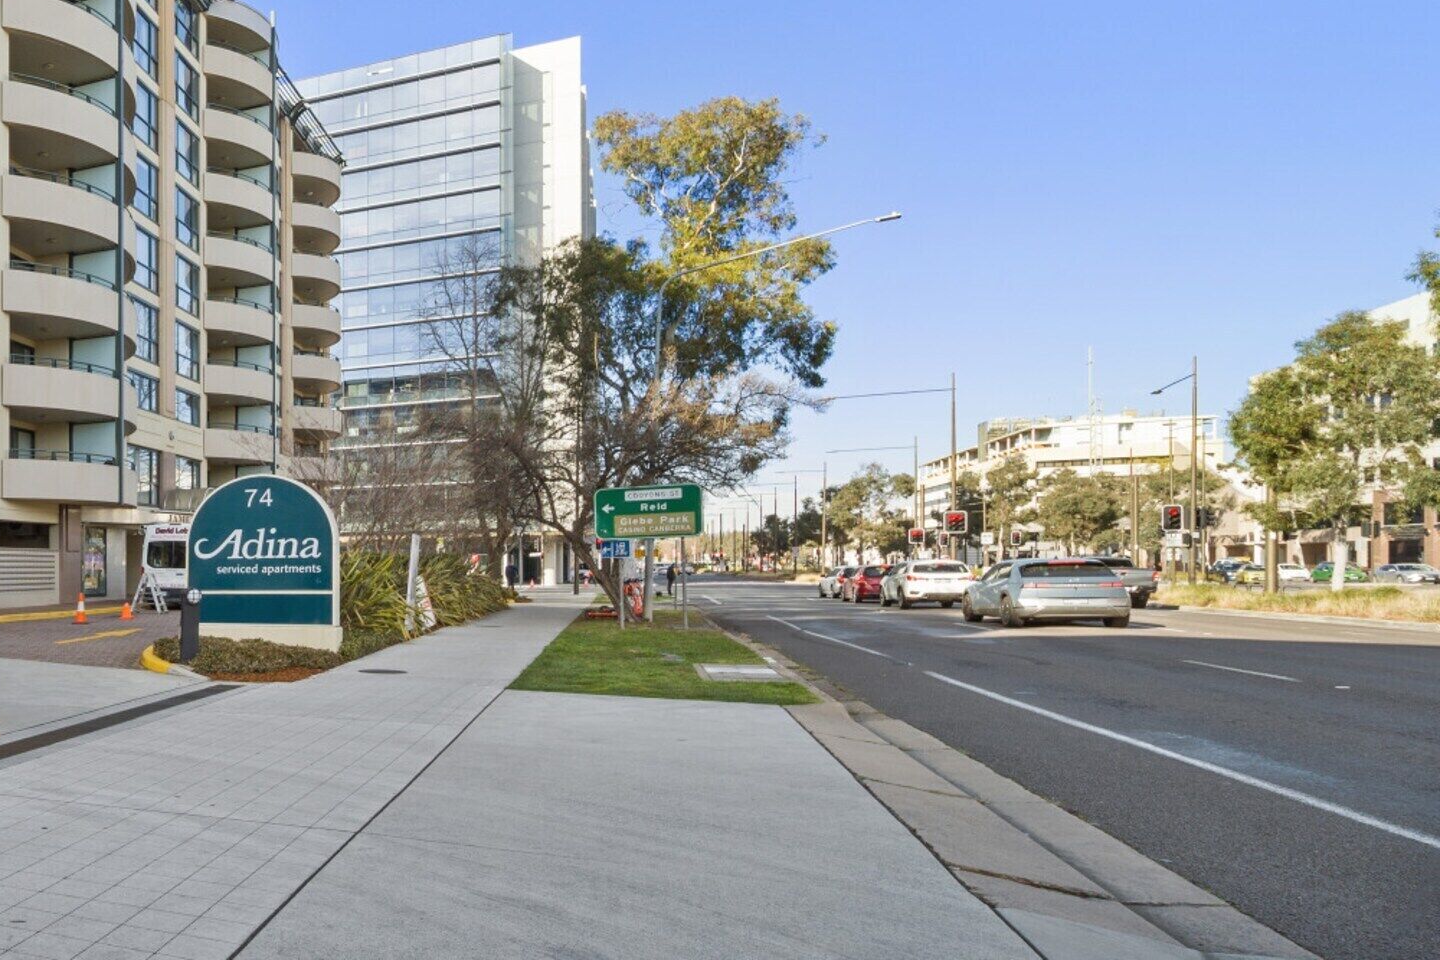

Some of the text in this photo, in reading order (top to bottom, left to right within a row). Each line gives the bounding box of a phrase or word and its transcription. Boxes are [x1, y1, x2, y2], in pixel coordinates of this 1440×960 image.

[244, 488, 273, 508] 74
[640, 502, 668, 512] Reid
[620, 514, 689, 526] Glebe Park
[155, 527, 174, 535] David
[618, 526, 646, 534] CASINO
[194, 527, 322, 560] Adina
[216, 564, 322, 576] serviced apartments
